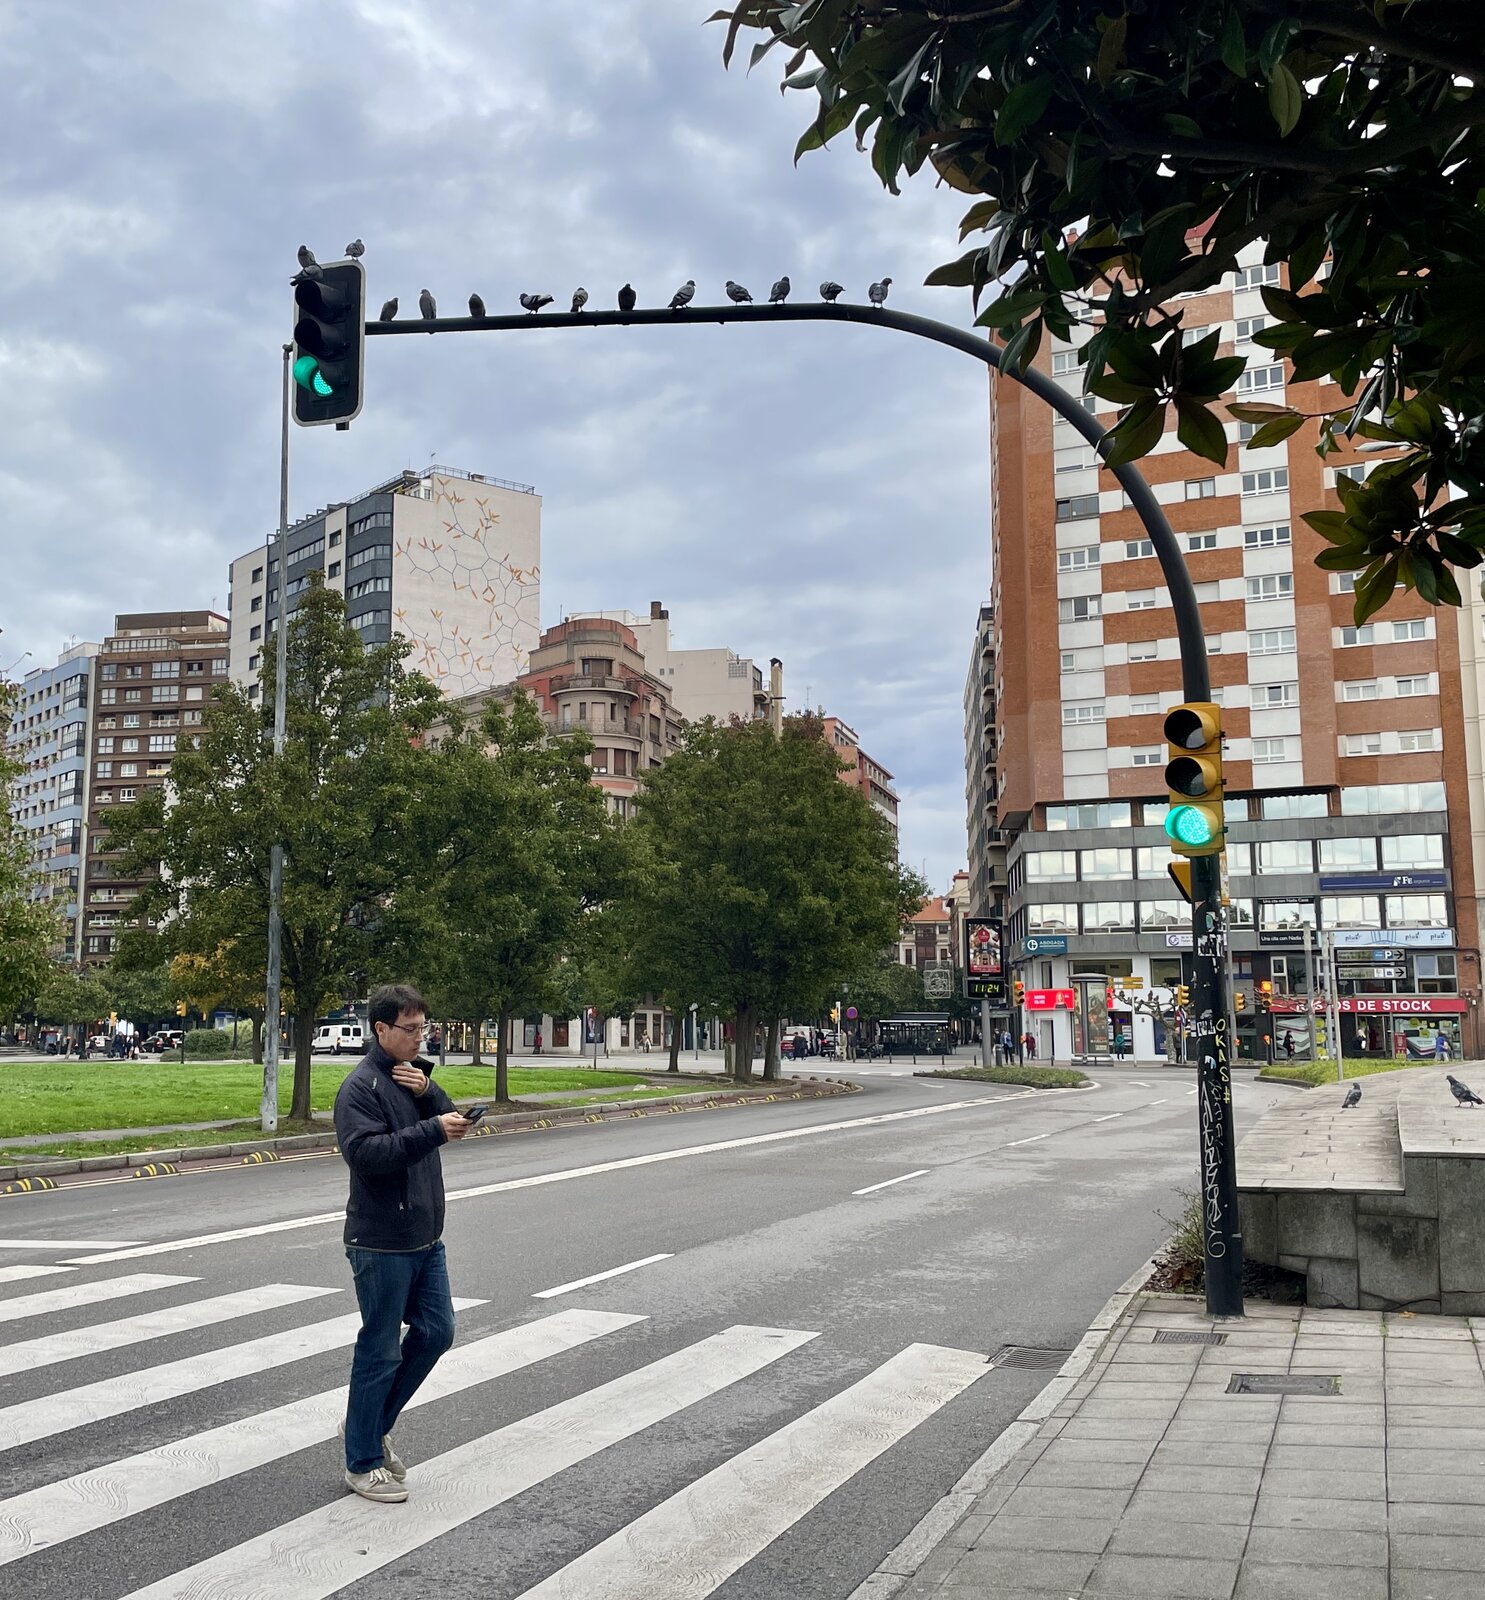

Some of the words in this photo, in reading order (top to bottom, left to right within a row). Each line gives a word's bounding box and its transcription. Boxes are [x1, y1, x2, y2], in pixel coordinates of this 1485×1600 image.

[1385, 950, 1393, 960] P
[1357, 1001, 1376, 1011] DE
[1382, 1000, 1432, 1011] STOCK
